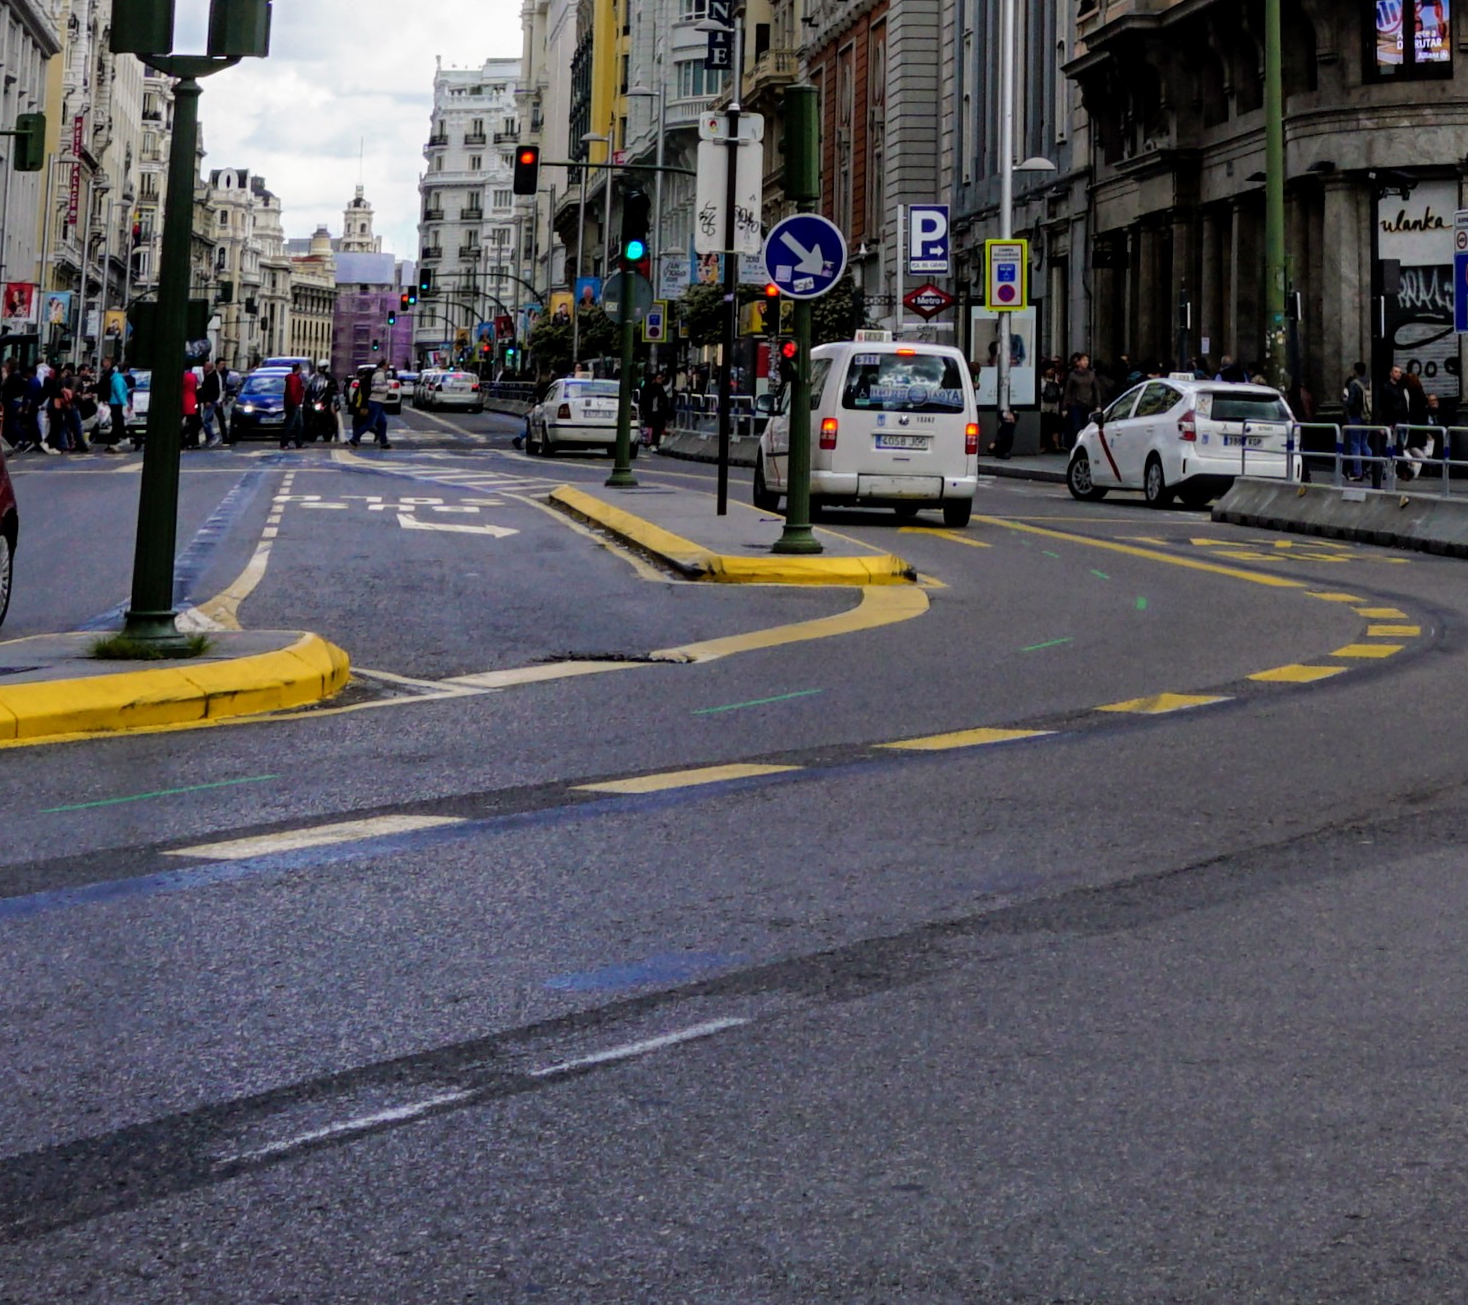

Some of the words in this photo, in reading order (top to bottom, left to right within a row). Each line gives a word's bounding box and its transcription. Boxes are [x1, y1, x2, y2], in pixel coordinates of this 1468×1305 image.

[1380, 206, 1453, 233] ulanka
[911, 210, 948, 258] P
[916, 295, 941, 305] Metro
